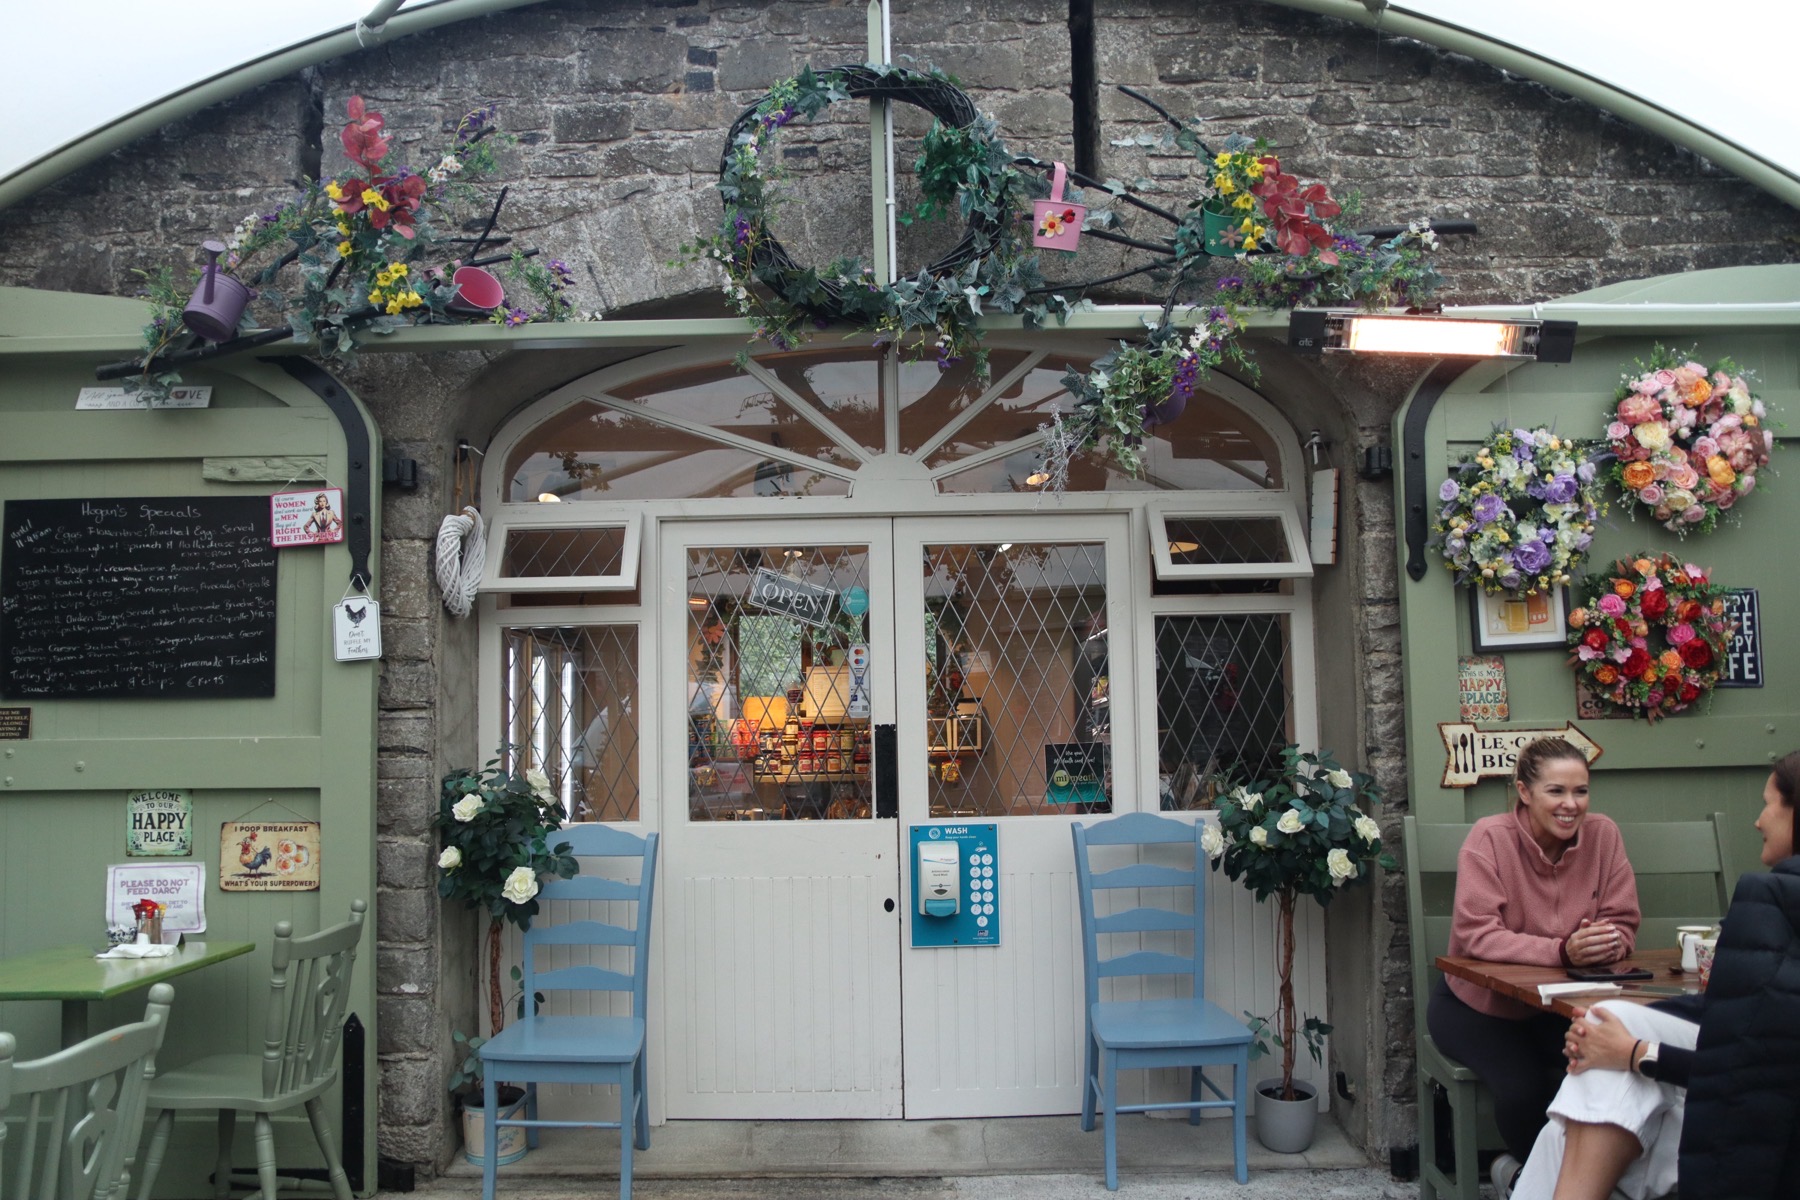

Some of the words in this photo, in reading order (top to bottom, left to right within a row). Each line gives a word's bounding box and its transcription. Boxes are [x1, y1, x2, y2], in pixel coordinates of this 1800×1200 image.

[275, 500, 307, 509] WOMEN
[140, 504, 202, 521] Specials
[280, 513, 299, 521] MEN
[275, 527, 301, 536] RIGHT
[275, 535, 292, 543] THE
[762, 583, 819, 614] OPEN
[1728, 653, 1756, 679] FE
[1459, 678, 1502, 691] HAPPY
[1465, 692, 1501, 704] PLACE
[1481, 737, 1504, 750] LE
[132, 791, 182, 804] WELCOME
[132, 812, 187, 829] HAPPY
[143, 831, 175, 842] PLACE
[945, 827, 968, 835] WASH
[120, 879, 154, 888] PLEASE
[127, 887, 150, 895] FEED
[152, 887, 181, 895] DARCY
